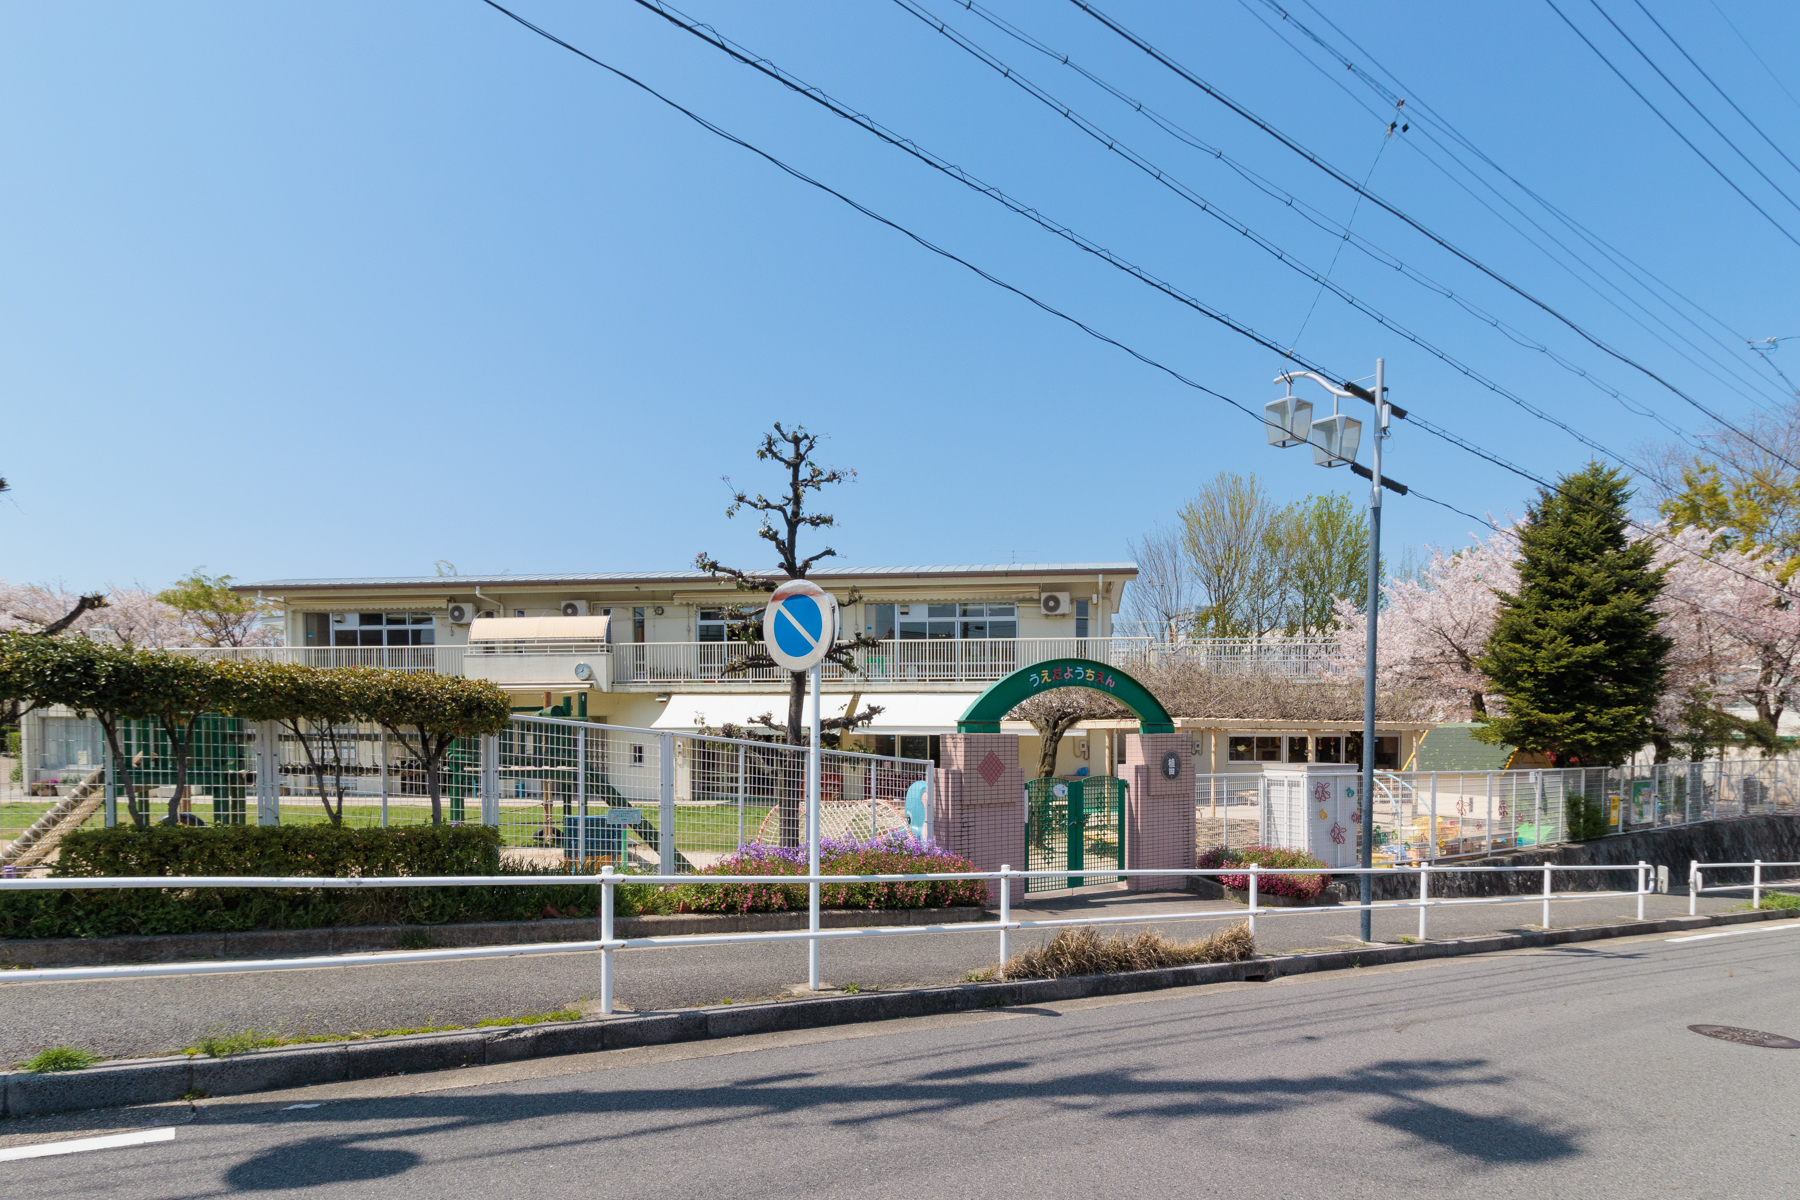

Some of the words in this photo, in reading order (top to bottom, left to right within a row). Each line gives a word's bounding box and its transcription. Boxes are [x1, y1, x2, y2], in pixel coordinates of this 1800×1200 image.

[1029, 666, 1116, 688] うえだようちえん
